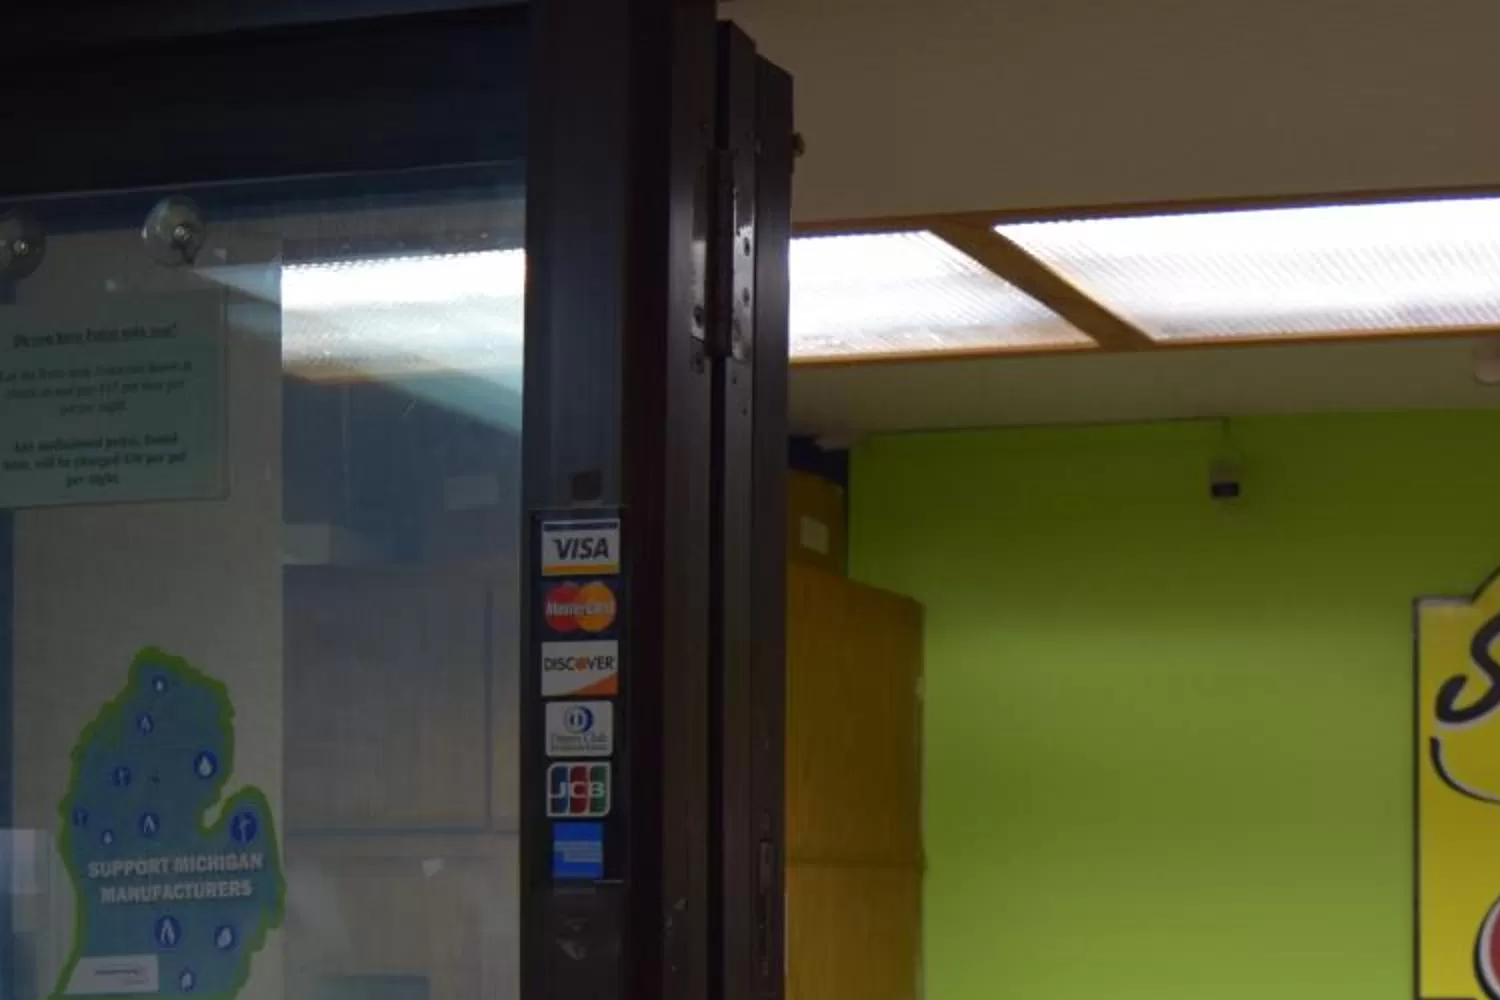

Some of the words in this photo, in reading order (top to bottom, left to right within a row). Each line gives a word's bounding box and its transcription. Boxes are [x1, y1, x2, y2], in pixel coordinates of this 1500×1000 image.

[553, 537, 610, 560] VISA
[544, 656, 615, 672] DISCOVER
[549, 780, 605, 798] JCB
[87, 859, 170, 878] SUPPORT
[173, 852, 264, 873] MICHIGAN
[100, 879, 253, 904] MANUFACTURERS
